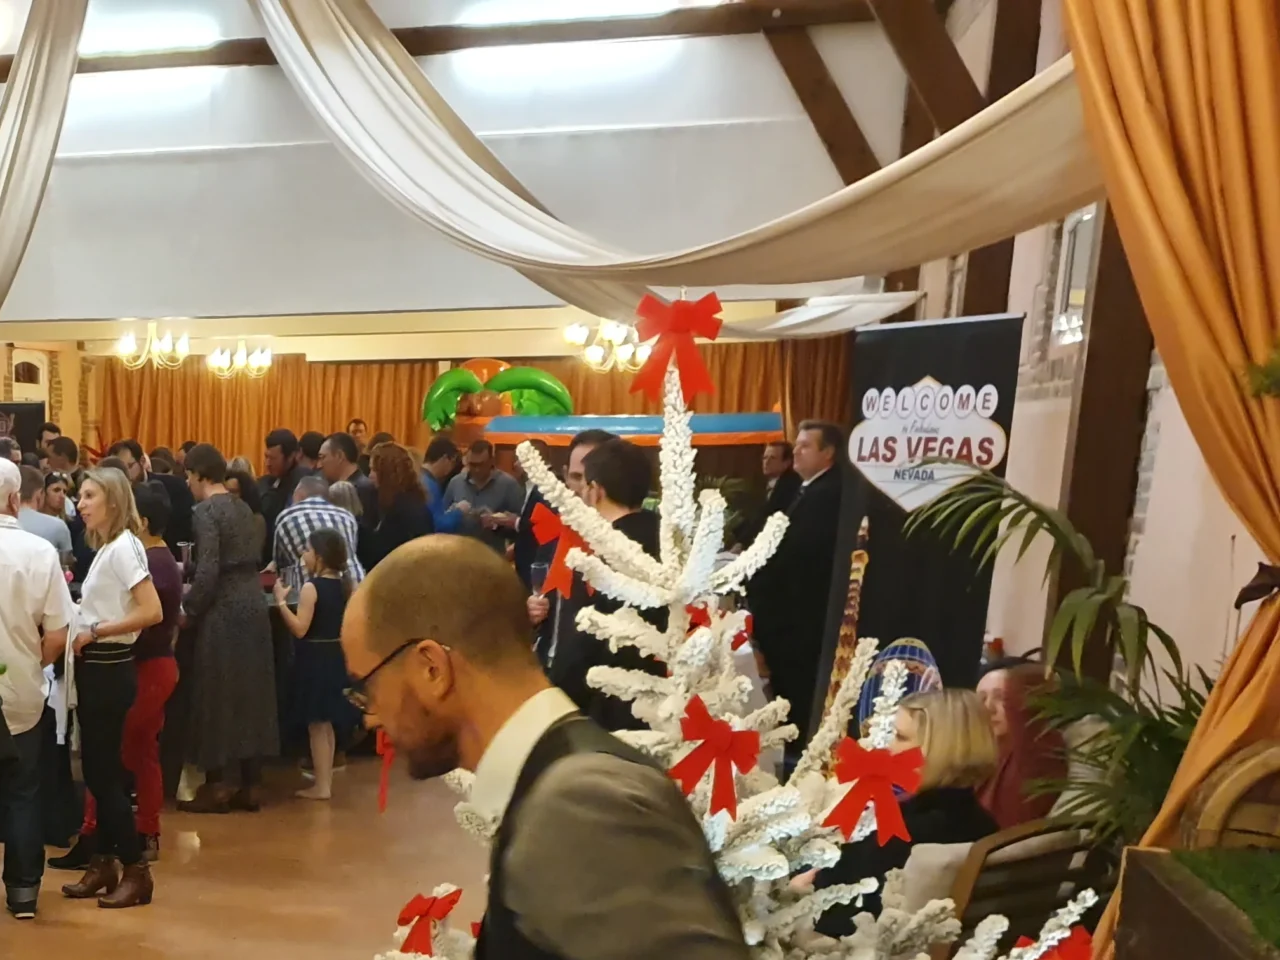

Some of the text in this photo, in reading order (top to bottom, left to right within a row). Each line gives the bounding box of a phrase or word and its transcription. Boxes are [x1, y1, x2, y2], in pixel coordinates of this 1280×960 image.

[866, 392, 992, 411] WELCOME
[857, 436, 995, 465] LAS VEGAS
[894, 469, 935, 481] NEVADA
